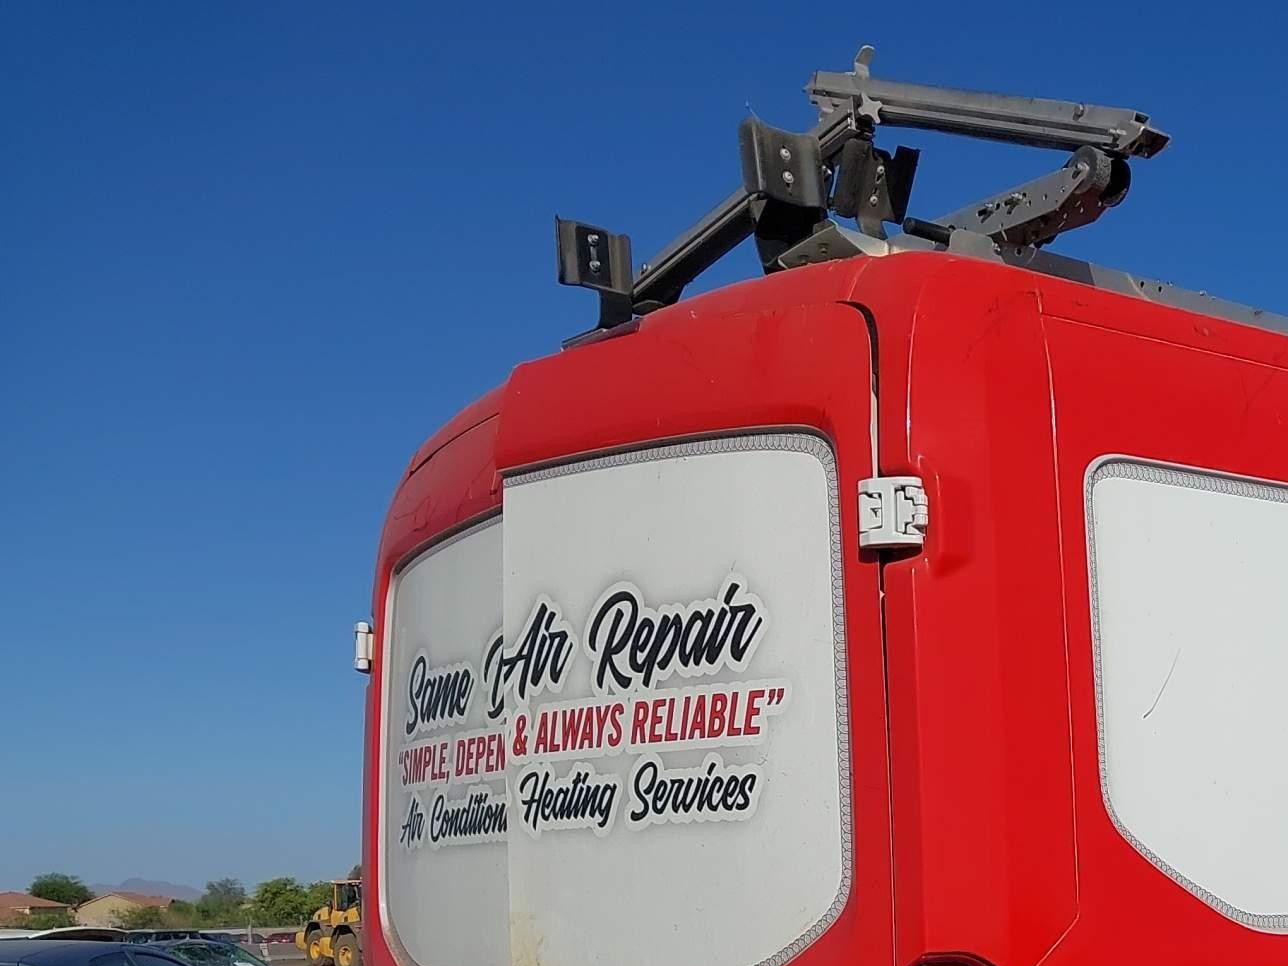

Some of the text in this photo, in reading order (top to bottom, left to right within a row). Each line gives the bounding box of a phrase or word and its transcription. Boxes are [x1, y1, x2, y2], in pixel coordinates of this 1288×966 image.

[503, 583, 763, 700] Air Repair
[406, 655, 474, 735] Same
[512, 688, 785, 756] & ALWAYS RELIABLE”
[399, 797, 426, 847] Air
[519, 761, 757, 832] Heating Services
